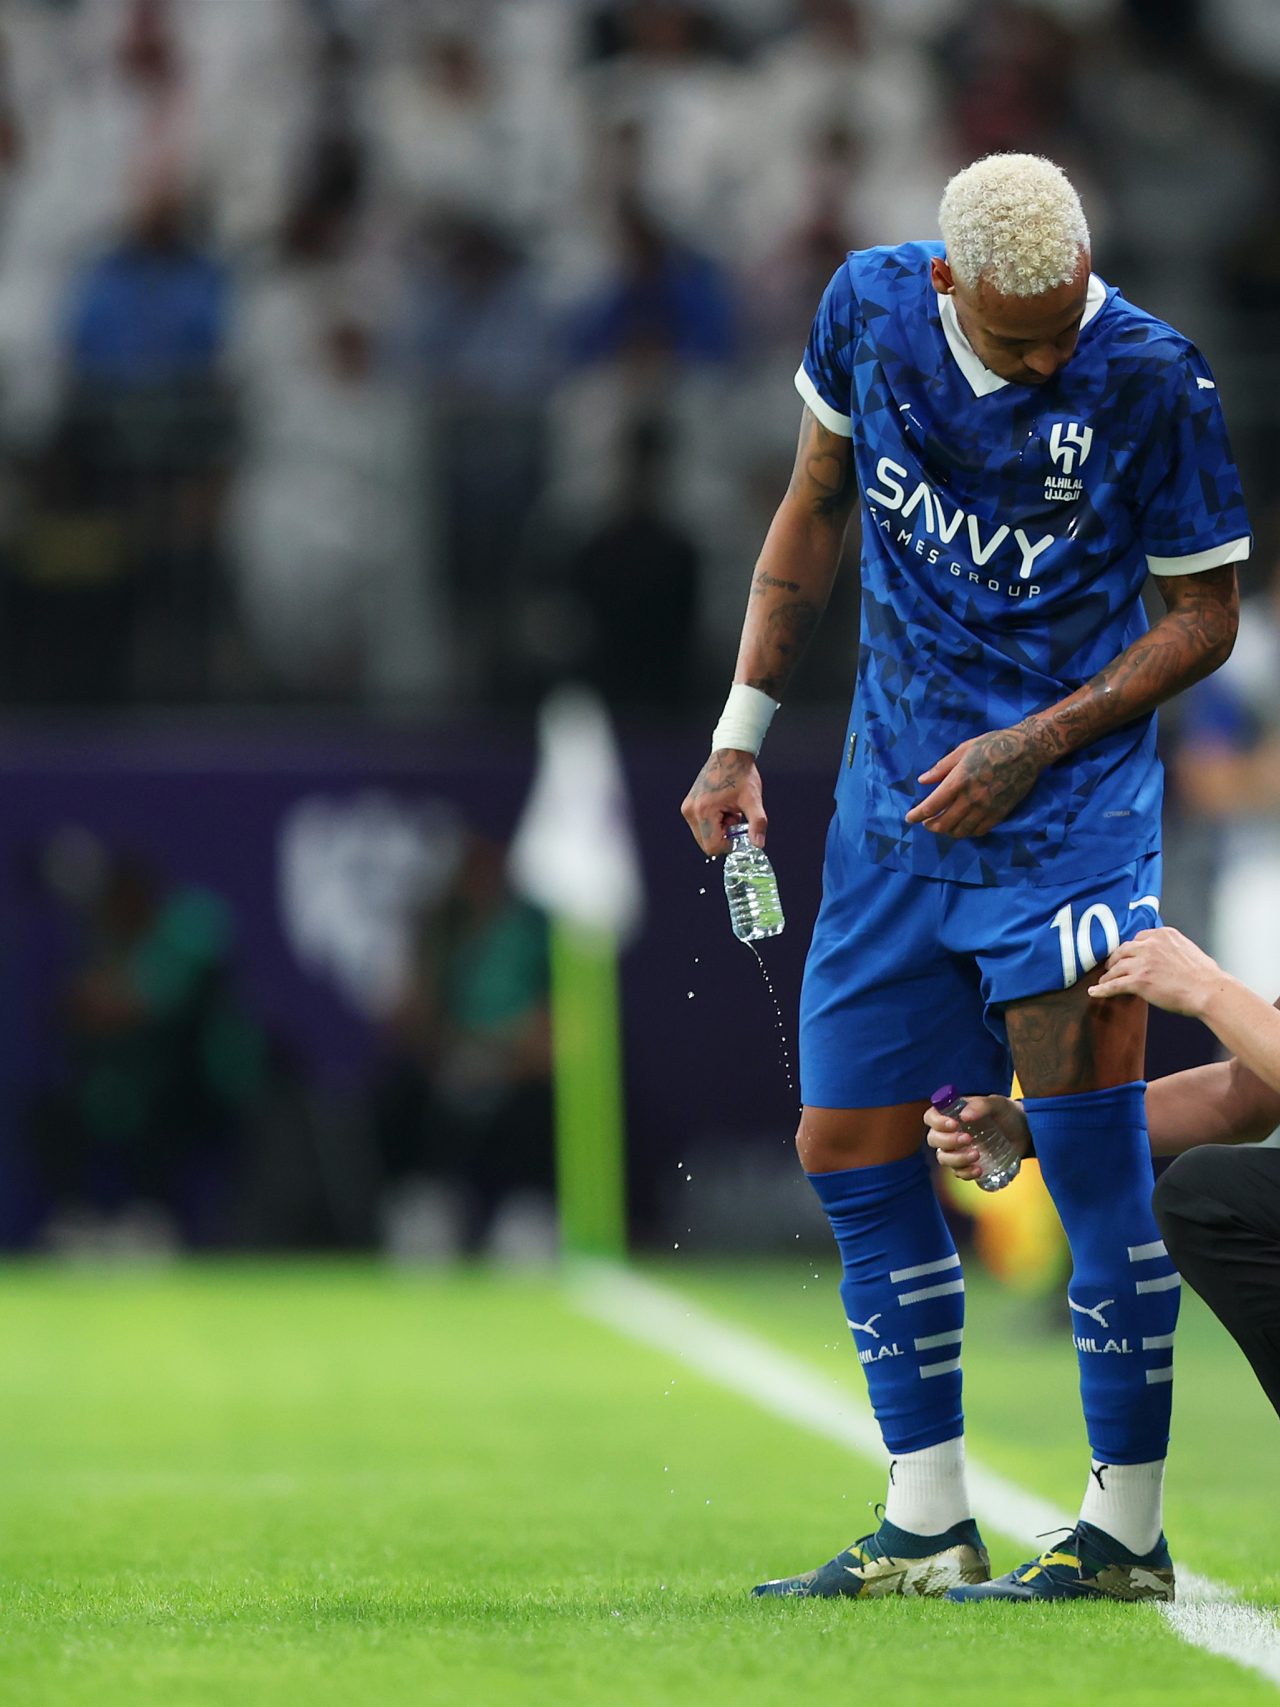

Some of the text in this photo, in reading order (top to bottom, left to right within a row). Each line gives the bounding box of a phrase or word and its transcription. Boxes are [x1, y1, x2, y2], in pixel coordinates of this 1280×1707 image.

[1044, 476, 1083, 489] ALHILAL
[866, 457, 1055, 579] SAVVY
[950, 562, 1041, 599] GROUP
[1050, 903, 1120, 989] 10
